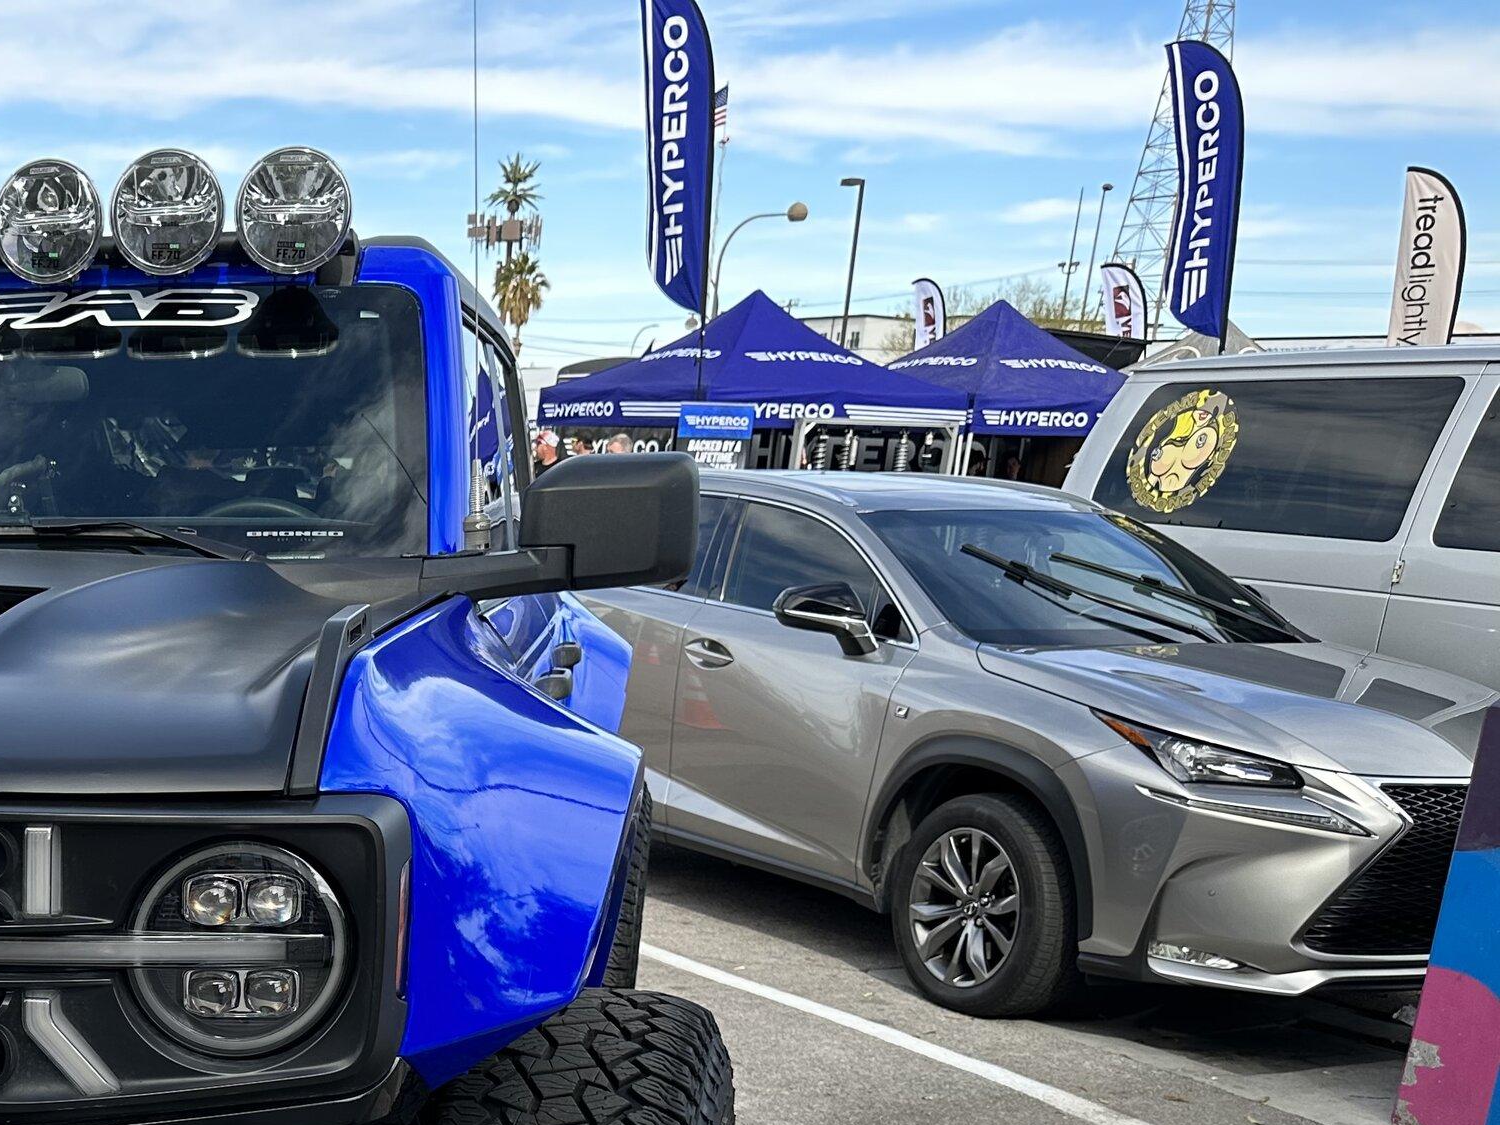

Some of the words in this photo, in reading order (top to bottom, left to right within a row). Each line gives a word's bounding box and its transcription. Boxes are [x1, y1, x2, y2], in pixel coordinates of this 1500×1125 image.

[661, 15, 689, 236] HYPERCO
[1184, 70, 1221, 269] HYPERCO
[770, 350, 863, 366] HYPERCO
[901, 356, 977, 370] HYPERCO
[1019, 359, 1107, 374] HYPERCO
[553, 401, 614, 417] HYPERCO
[754, 403, 835, 420] YPERCO
[696, 416, 749, 426] HYPERCO
[1000, 410, 1088, 428] HYPERCO
